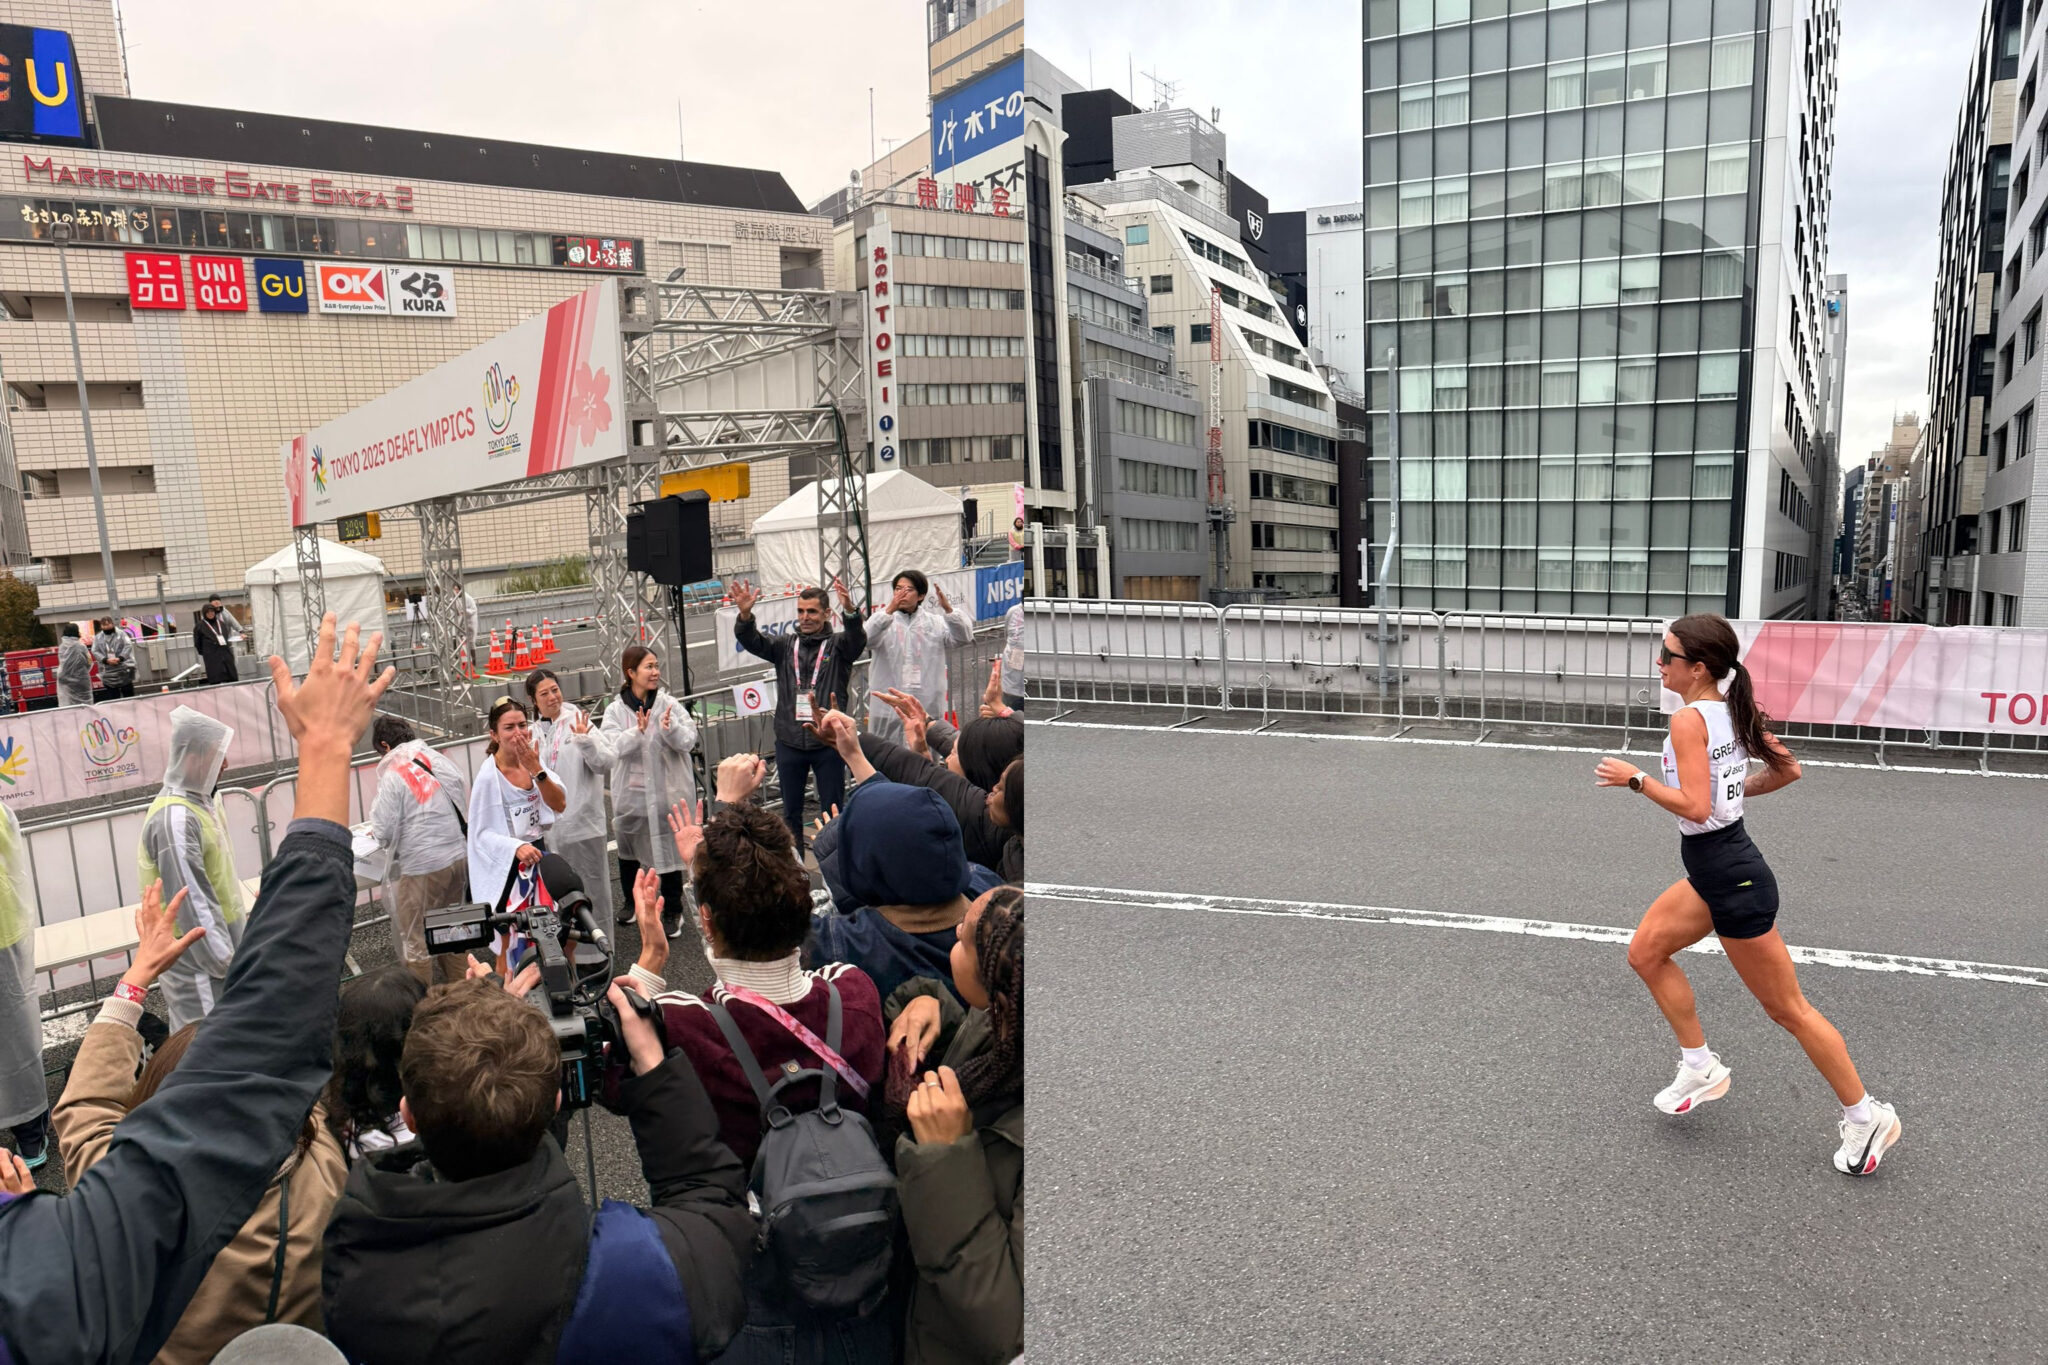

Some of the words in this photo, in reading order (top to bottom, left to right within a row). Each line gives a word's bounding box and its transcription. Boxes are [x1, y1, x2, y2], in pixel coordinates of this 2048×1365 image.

[964, 90, 1024, 143] 木下の
[23, 154, 215, 195] MARRONNIER
[225, 171, 300, 202] GATE
[310, 179, 389, 208] GINZA
[396, 186, 414, 211] 2
[587, 245, 633, 267] しゃぶ葉
[197, 262, 236, 282] UNI
[200, 285, 242, 306] QLO
[261, 273, 304, 298] GU
[328, 267, 385, 302] OK
[400, 272, 444, 299] くら
[402, 299, 446, 312] KURA
[330, 450, 360, 481] TOKYO
[361, 444, 386, 471] 2025
[387, 406, 476, 463] DEAFLYMPICS
[487, 437, 505, 450] TOKYO
[506, 432, 519, 446] 2025
[928, 592, 966, 609] SoBank
[85, 767, 114, 777] TOKYO
[116, 762, 136, 773] 2025
